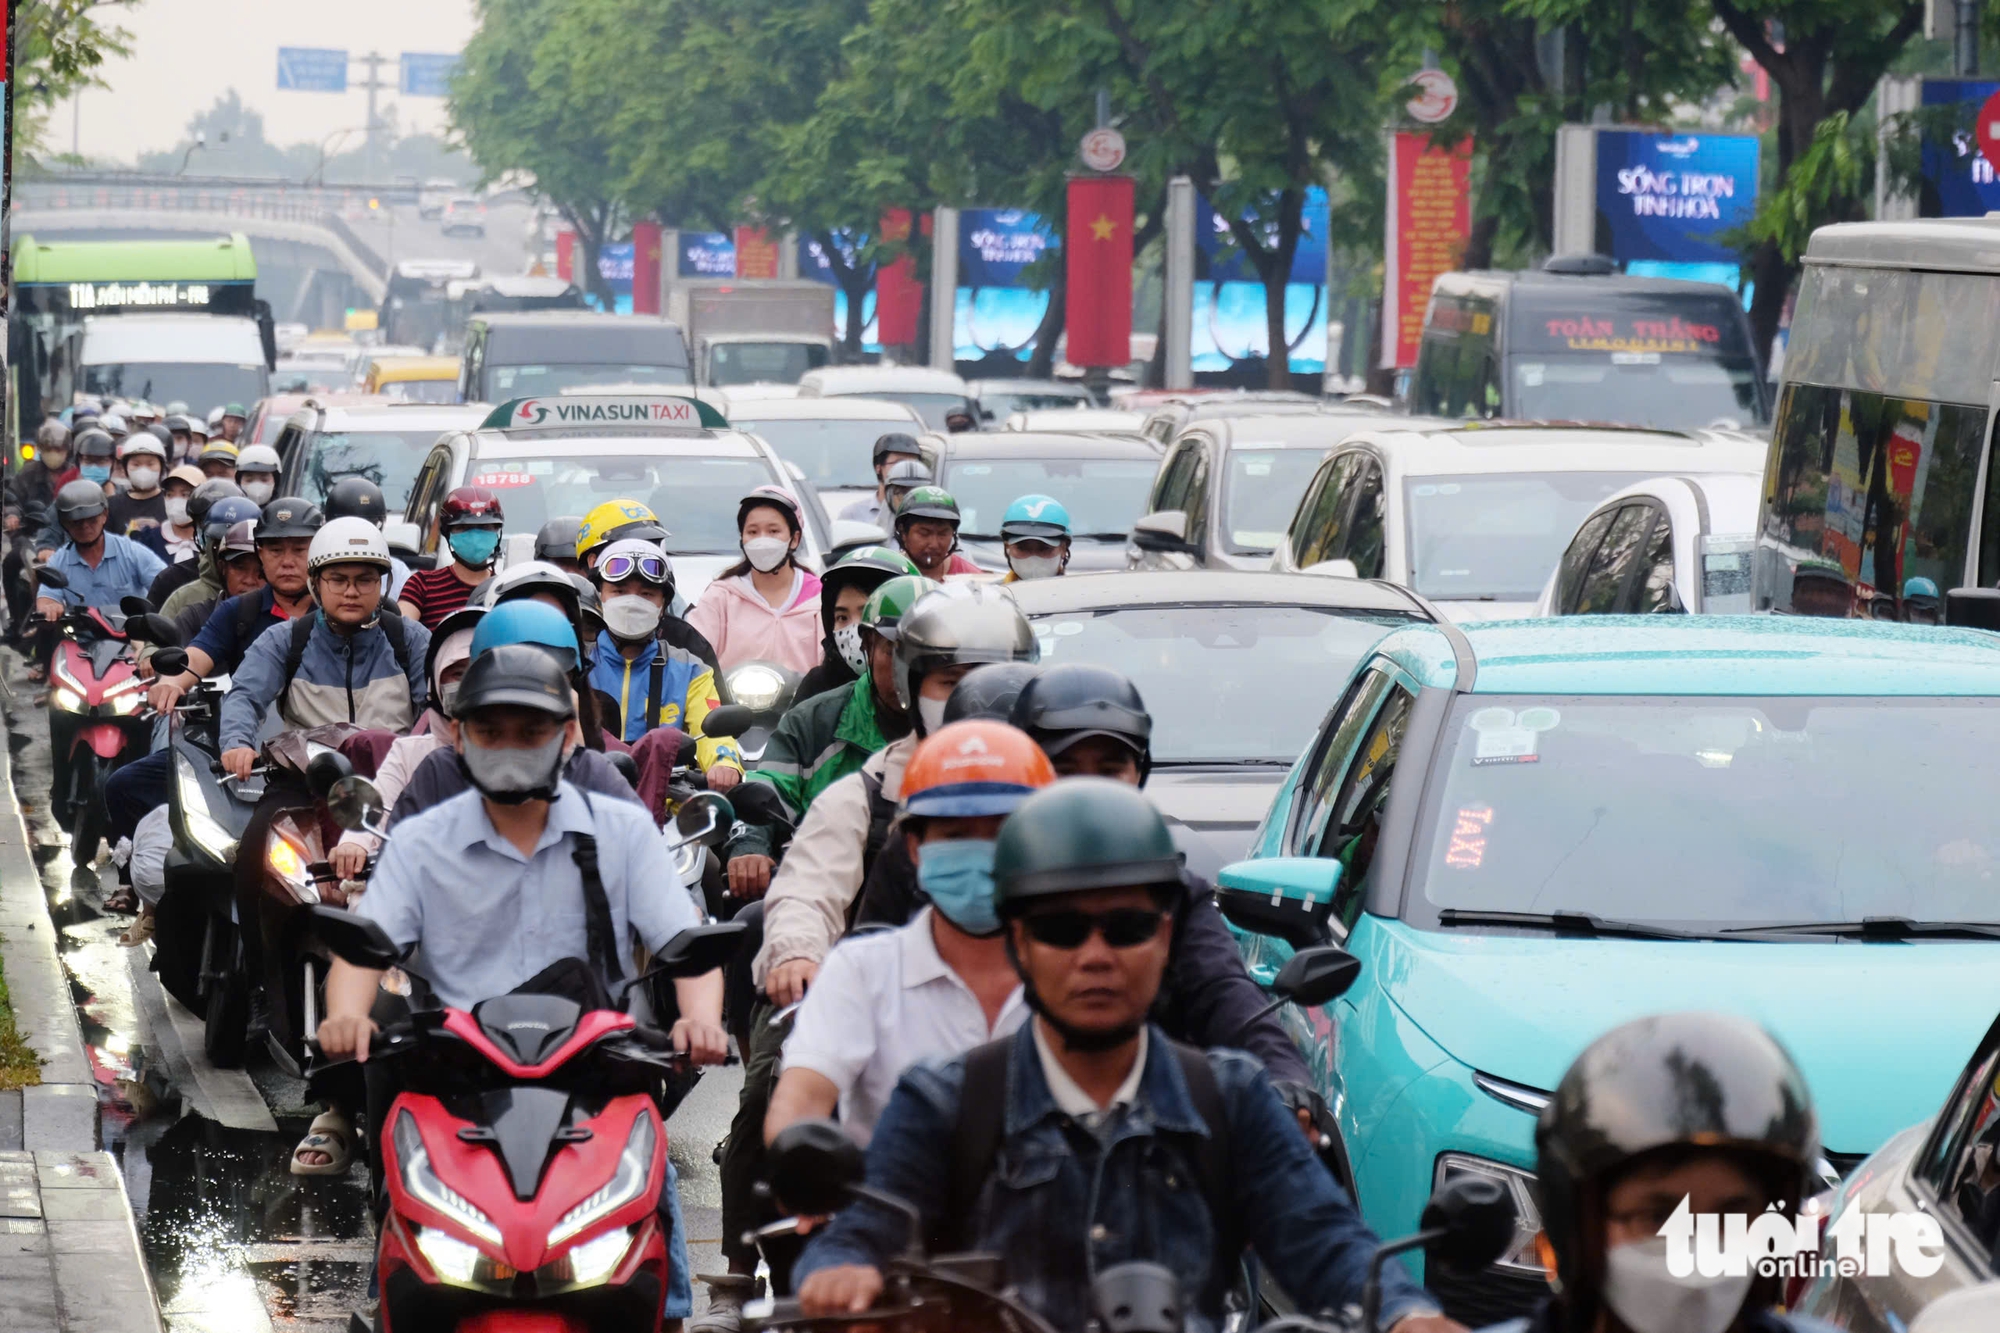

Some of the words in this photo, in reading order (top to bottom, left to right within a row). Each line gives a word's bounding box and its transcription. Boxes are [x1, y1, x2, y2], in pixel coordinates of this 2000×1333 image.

[1617, 164, 1676, 195] SỐNG
[556, 404, 649, 421] VINASUN
[651, 404, 690, 420] TAXI
[1446, 808, 1493, 867] TAXI
